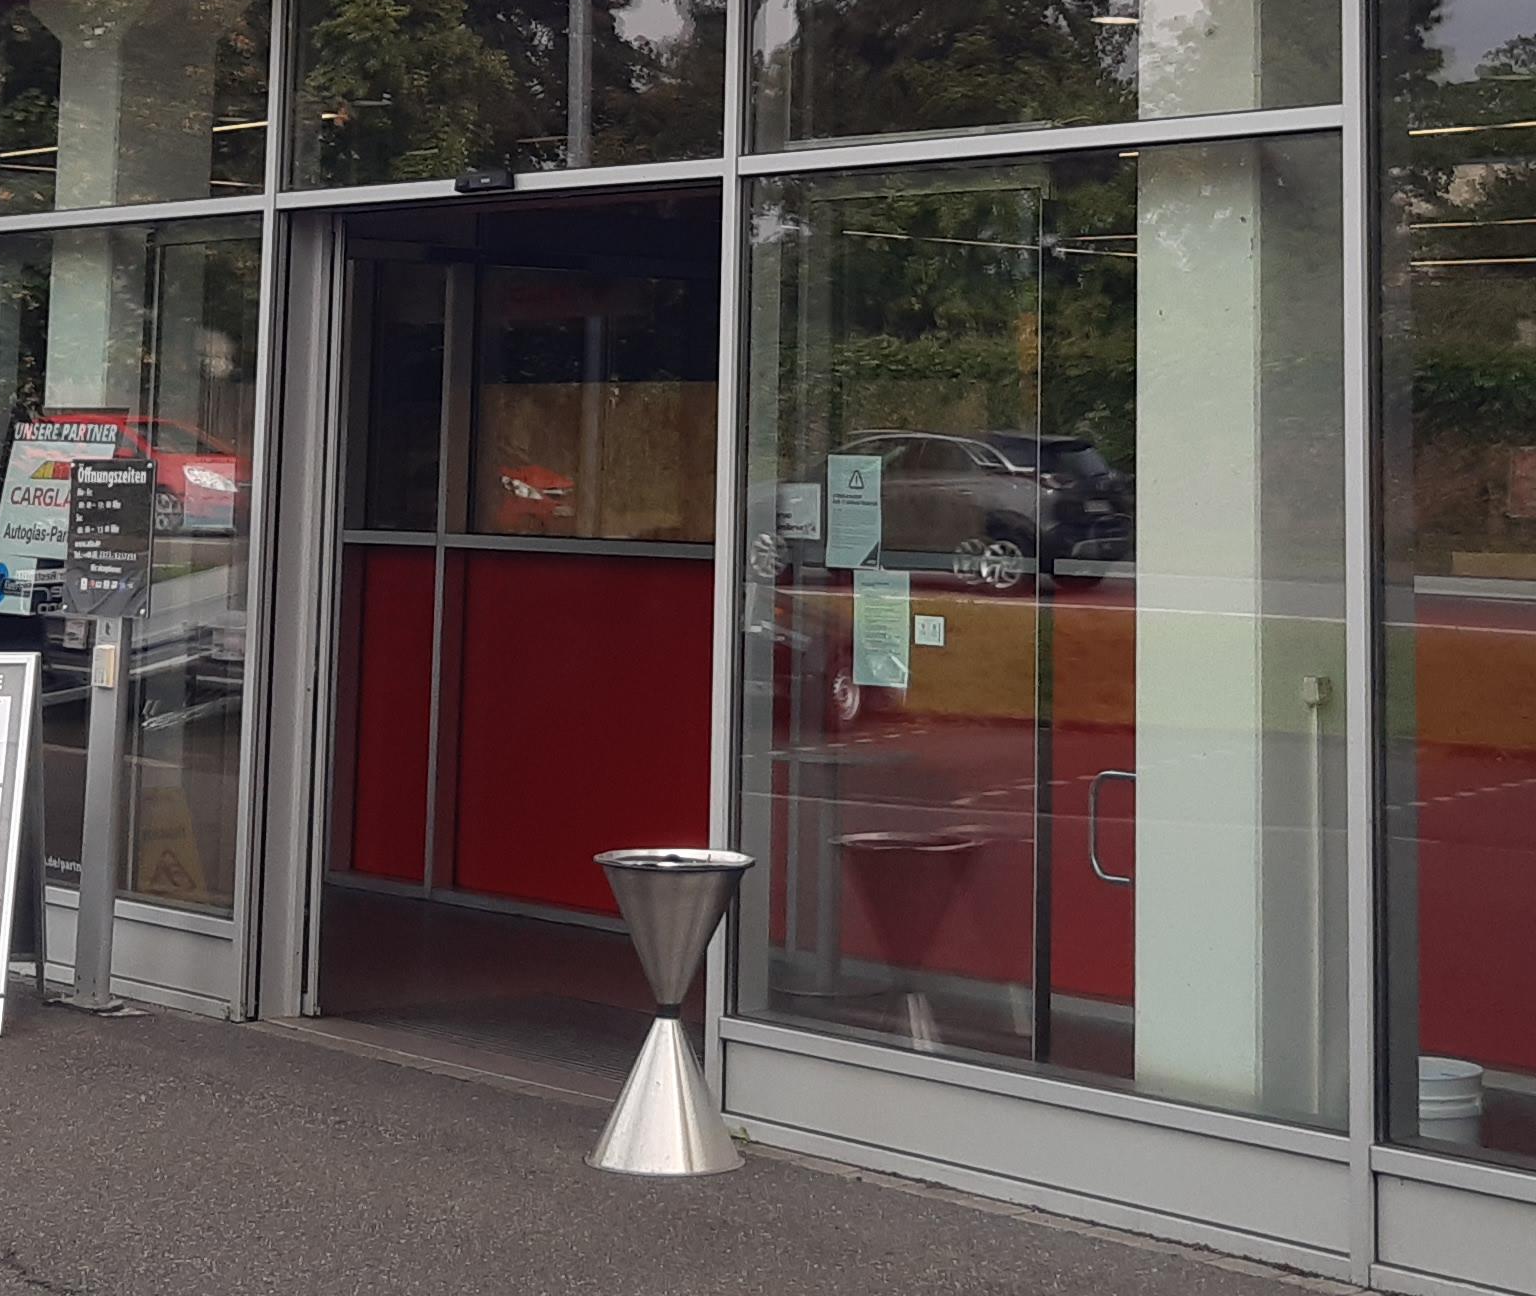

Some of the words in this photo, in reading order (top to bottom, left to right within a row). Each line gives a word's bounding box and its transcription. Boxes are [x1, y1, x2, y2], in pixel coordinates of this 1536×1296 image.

[14, 421, 61, 440] UNSERE
[62, 423, 118, 442] PARTNER
[77, 463, 147, 488] Öffnungszeiten
